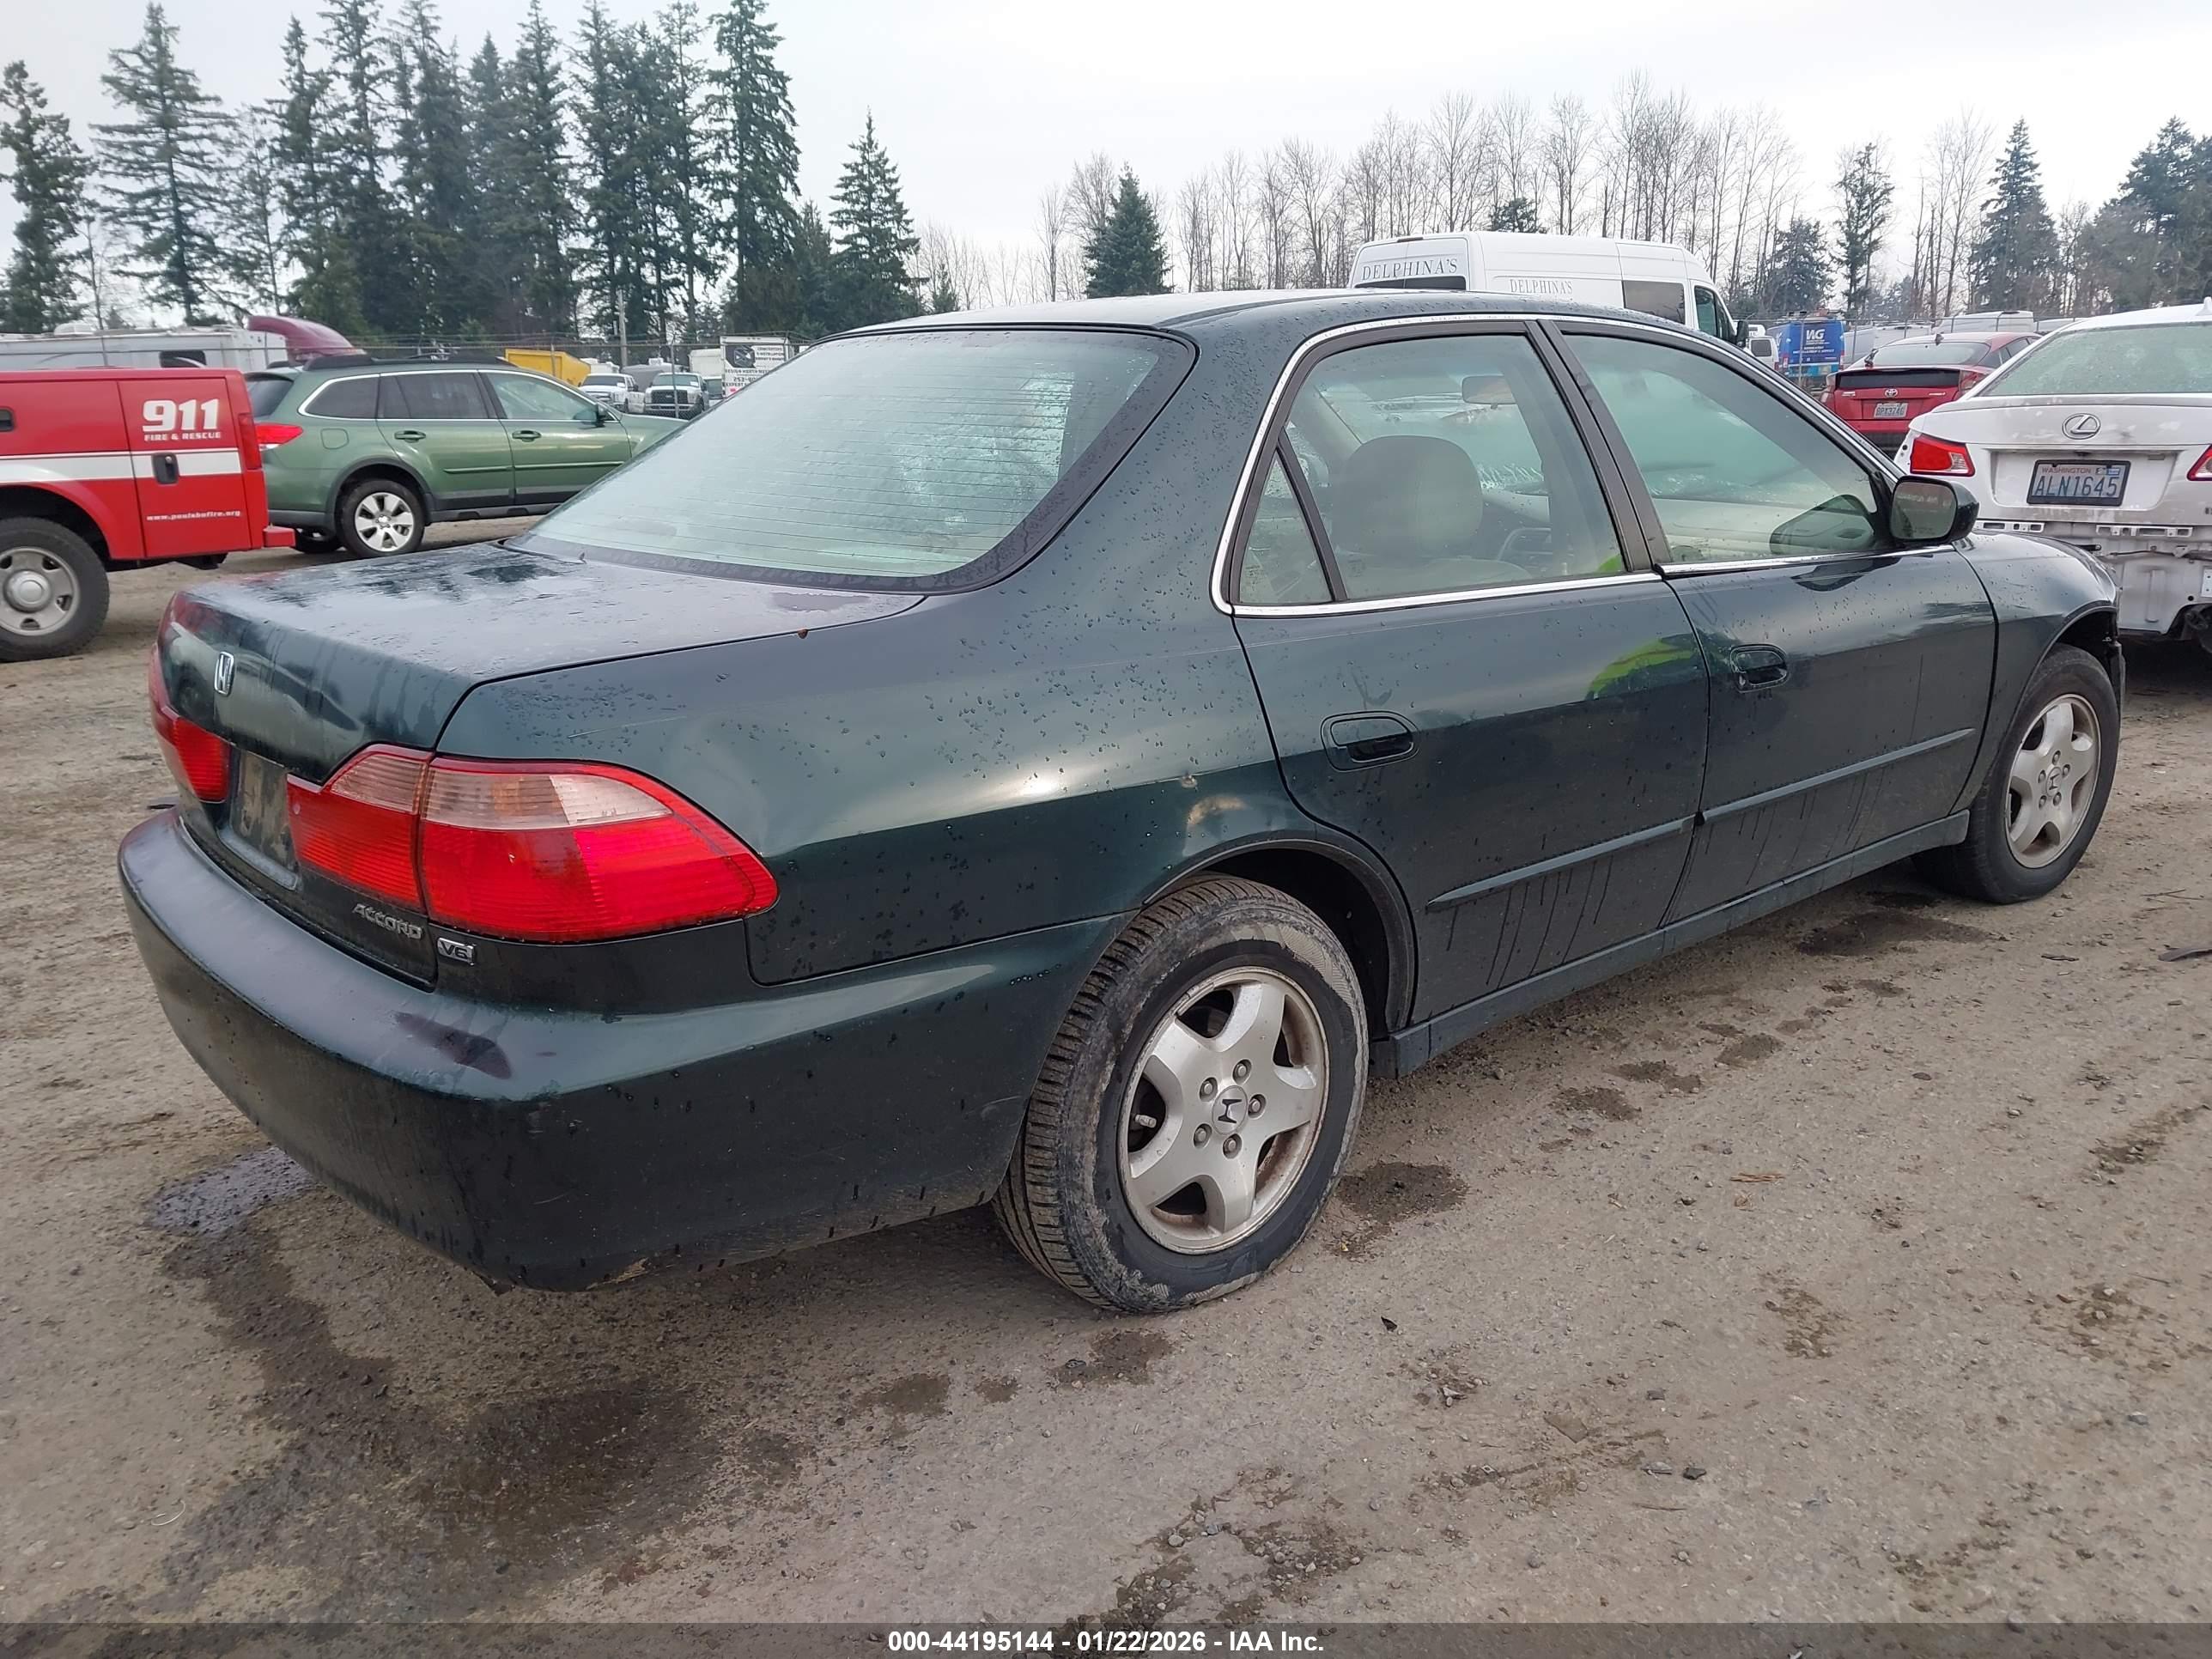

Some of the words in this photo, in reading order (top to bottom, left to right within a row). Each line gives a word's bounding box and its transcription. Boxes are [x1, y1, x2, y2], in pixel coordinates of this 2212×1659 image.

[1363, 258, 1458, 280] DELPHINA'S
[1510, 278, 1573, 295] DELPHINA'S
[143, 398, 219, 432] 911
[144, 433, 167, 441] FIRE
[2034, 476, 2120, 497] ALN1645
[352, 903, 423, 939] ACCORD
[441, 941, 468, 959] V6
